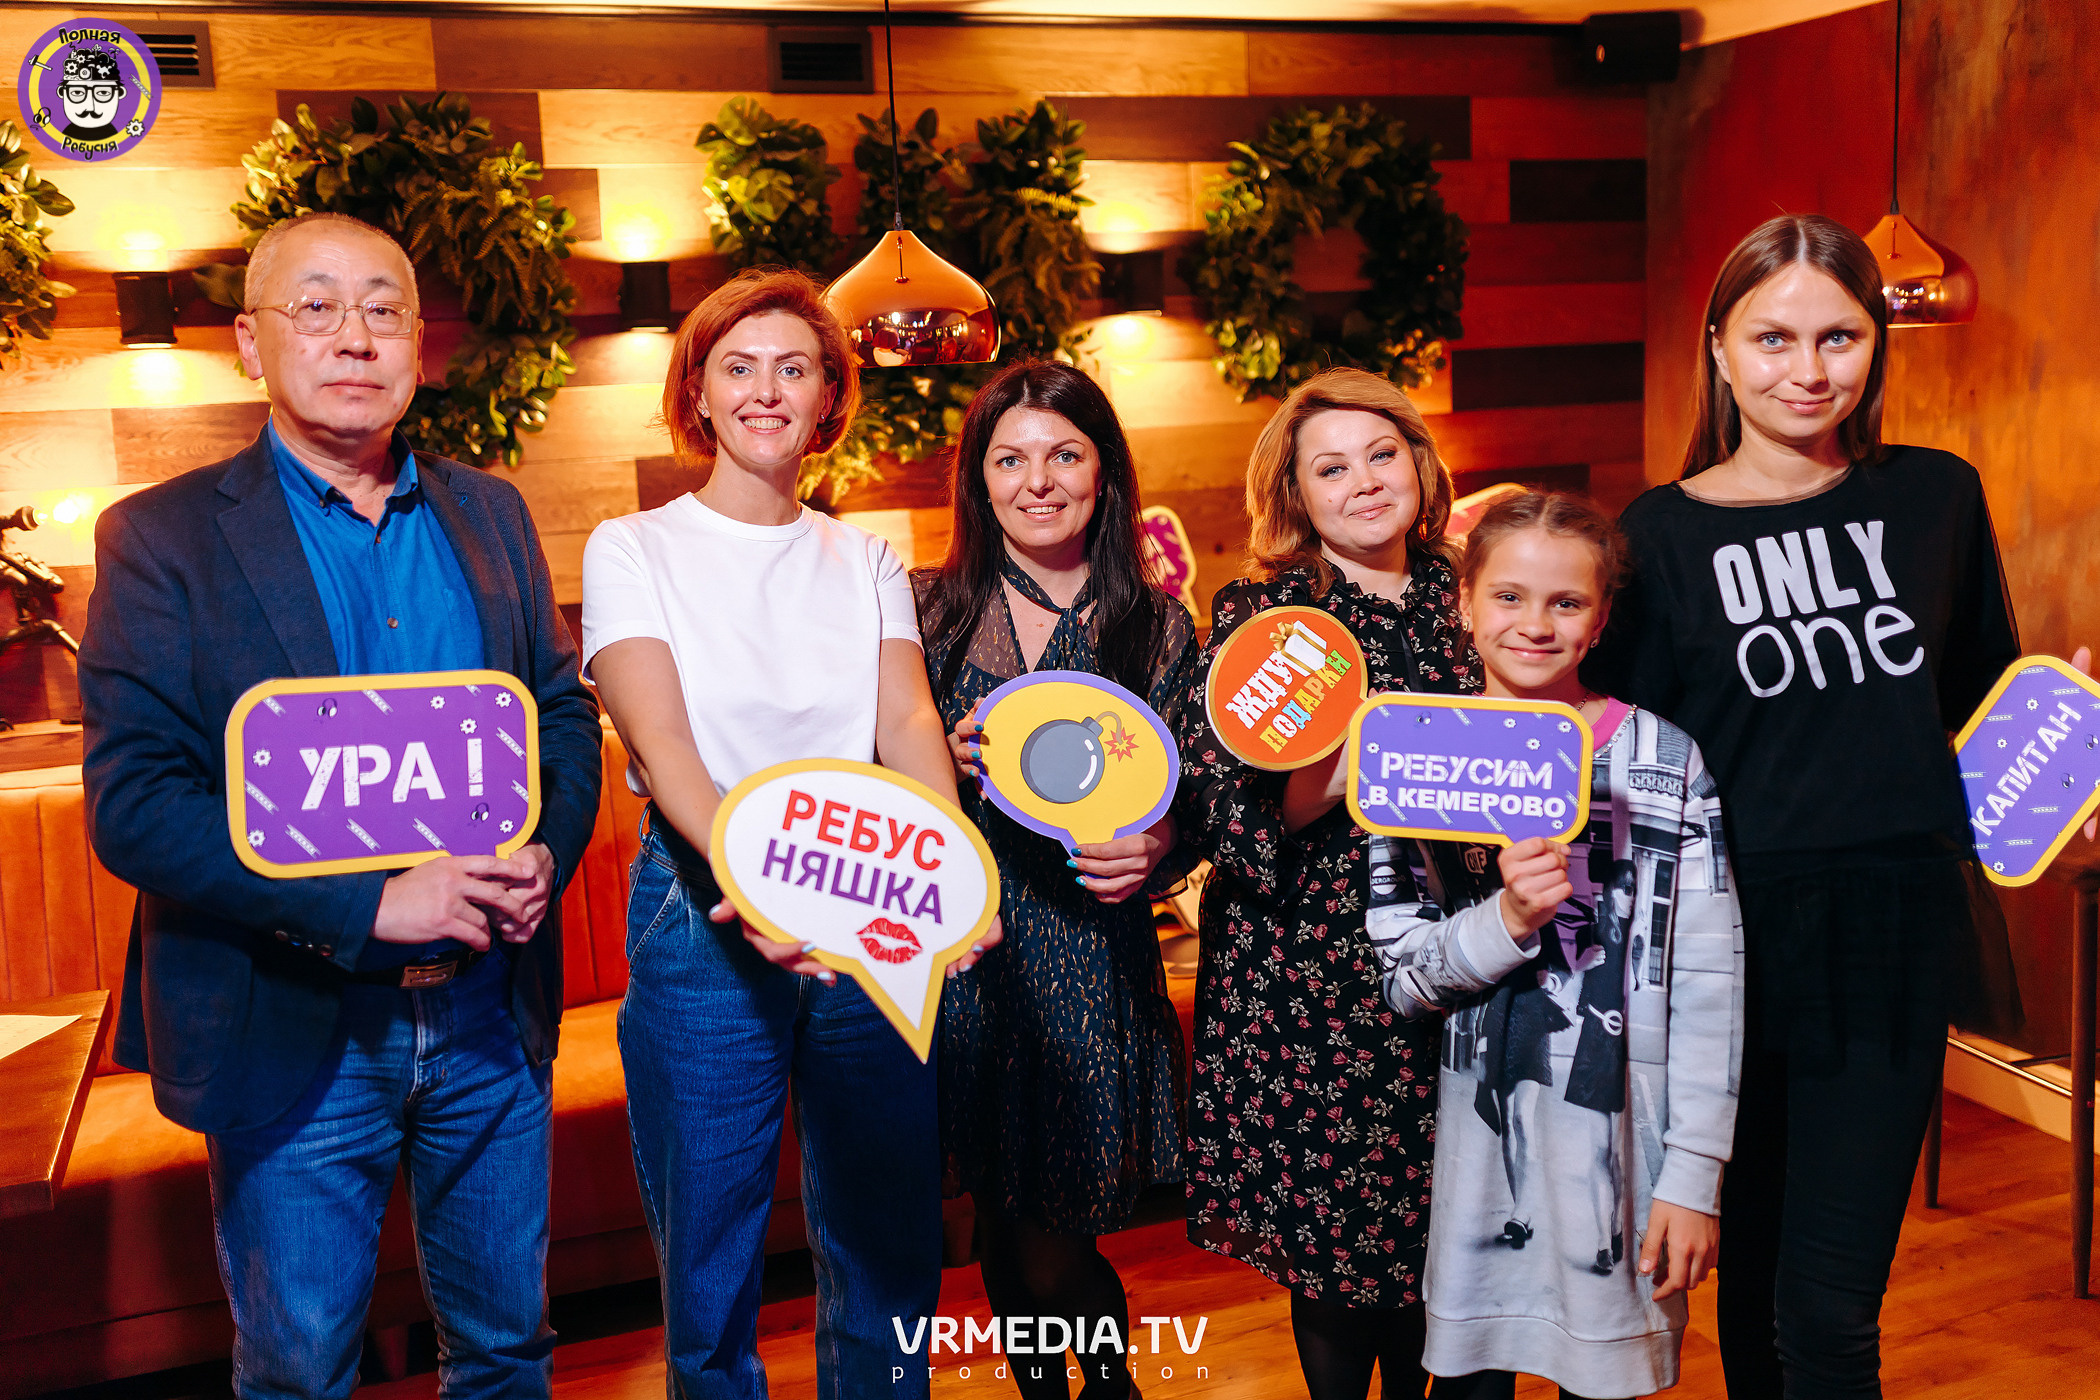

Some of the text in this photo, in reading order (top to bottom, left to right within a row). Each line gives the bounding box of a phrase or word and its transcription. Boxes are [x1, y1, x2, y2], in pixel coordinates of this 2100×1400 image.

[1712, 519, 1897, 625] ONLY
[1225, 650, 1293, 730] ЖДУ
[1736, 604, 1925, 698] one
[1259, 649, 1352, 754] ПОДАРКИ
[1369, 785, 1567, 818] В КЕМЕРОВО
[1380, 751, 1553, 790] РЕБУСИМ
[1969, 702, 2082, 836] КАПИТАН
[782, 789, 946, 871] РЕБУС
[762, 838, 943, 925] НЯШКА
